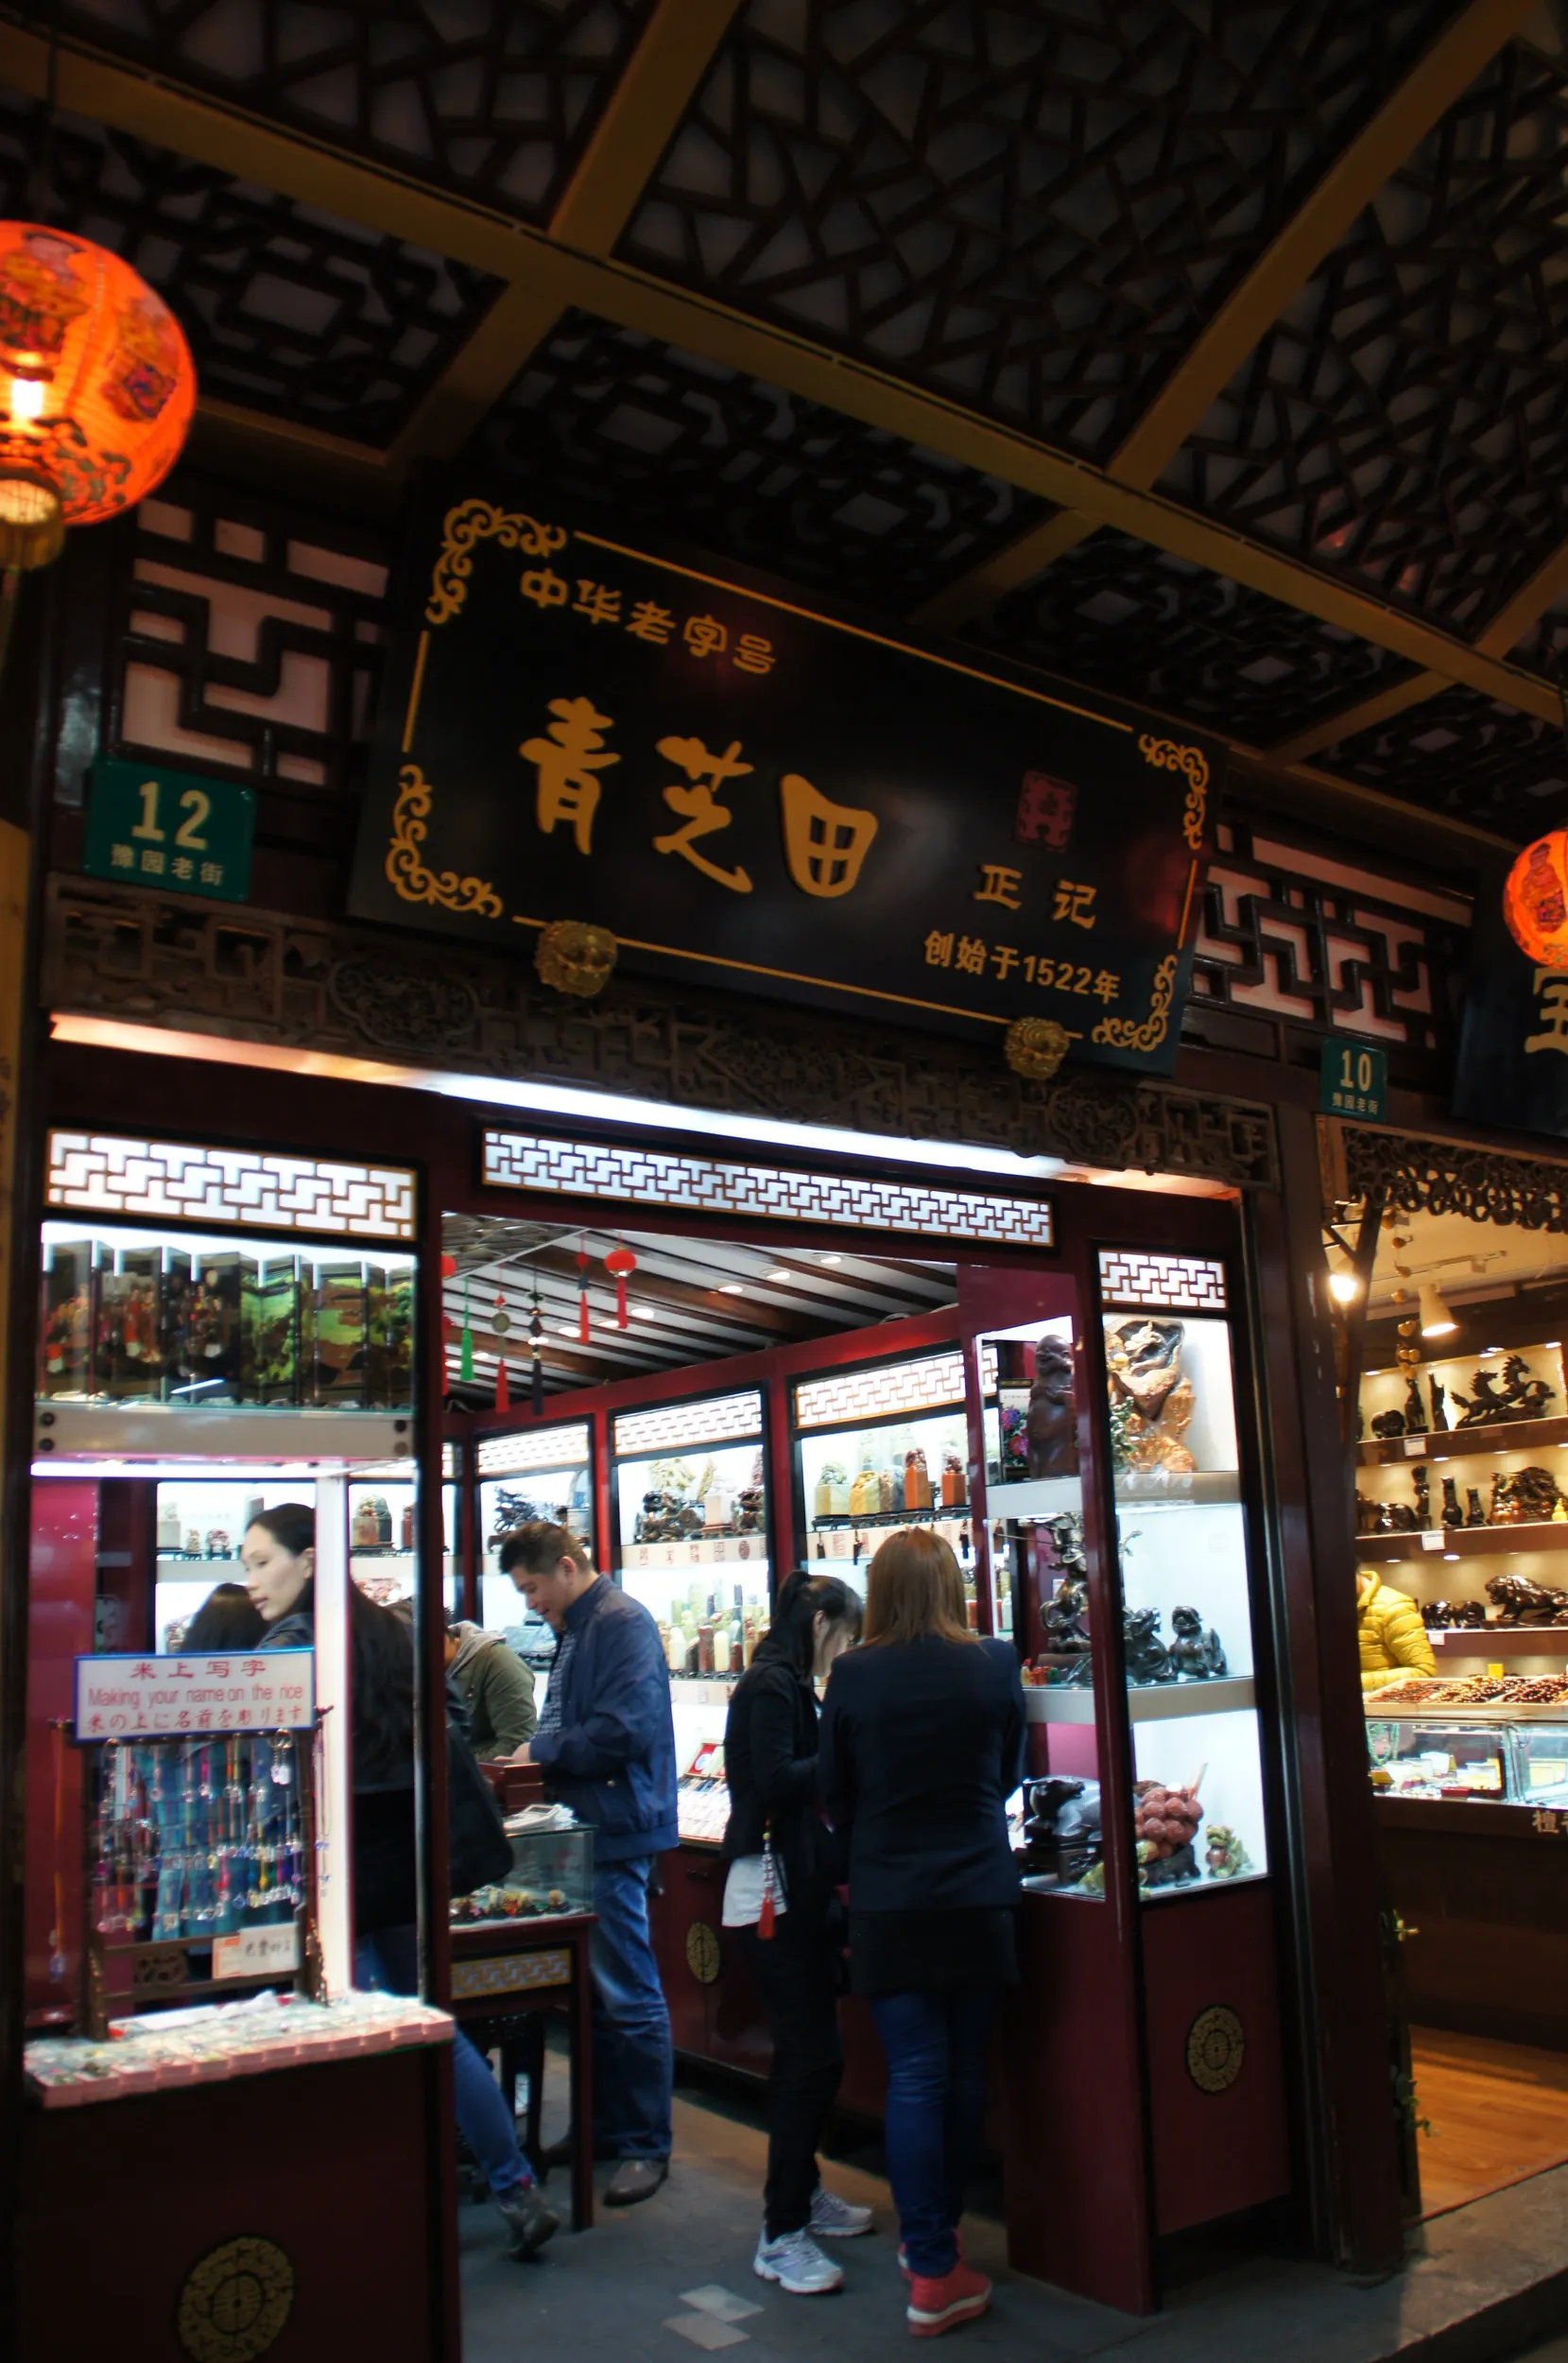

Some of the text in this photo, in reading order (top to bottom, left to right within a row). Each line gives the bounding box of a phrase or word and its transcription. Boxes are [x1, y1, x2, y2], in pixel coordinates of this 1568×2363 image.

[520, 567, 776, 674] 中华老字号
[130, 781, 211, 850] 12
[519, 696, 878, 898] 青芝田
[974, 864, 1097, 929] 正记
[923, 930, 1121, 1005] 创始于1522年
[1340, 1049, 1372, 1092] 10
[88, 1683, 302, 1710] Making your name on the rice
[129, 1659, 267, 1681] 米上写字
